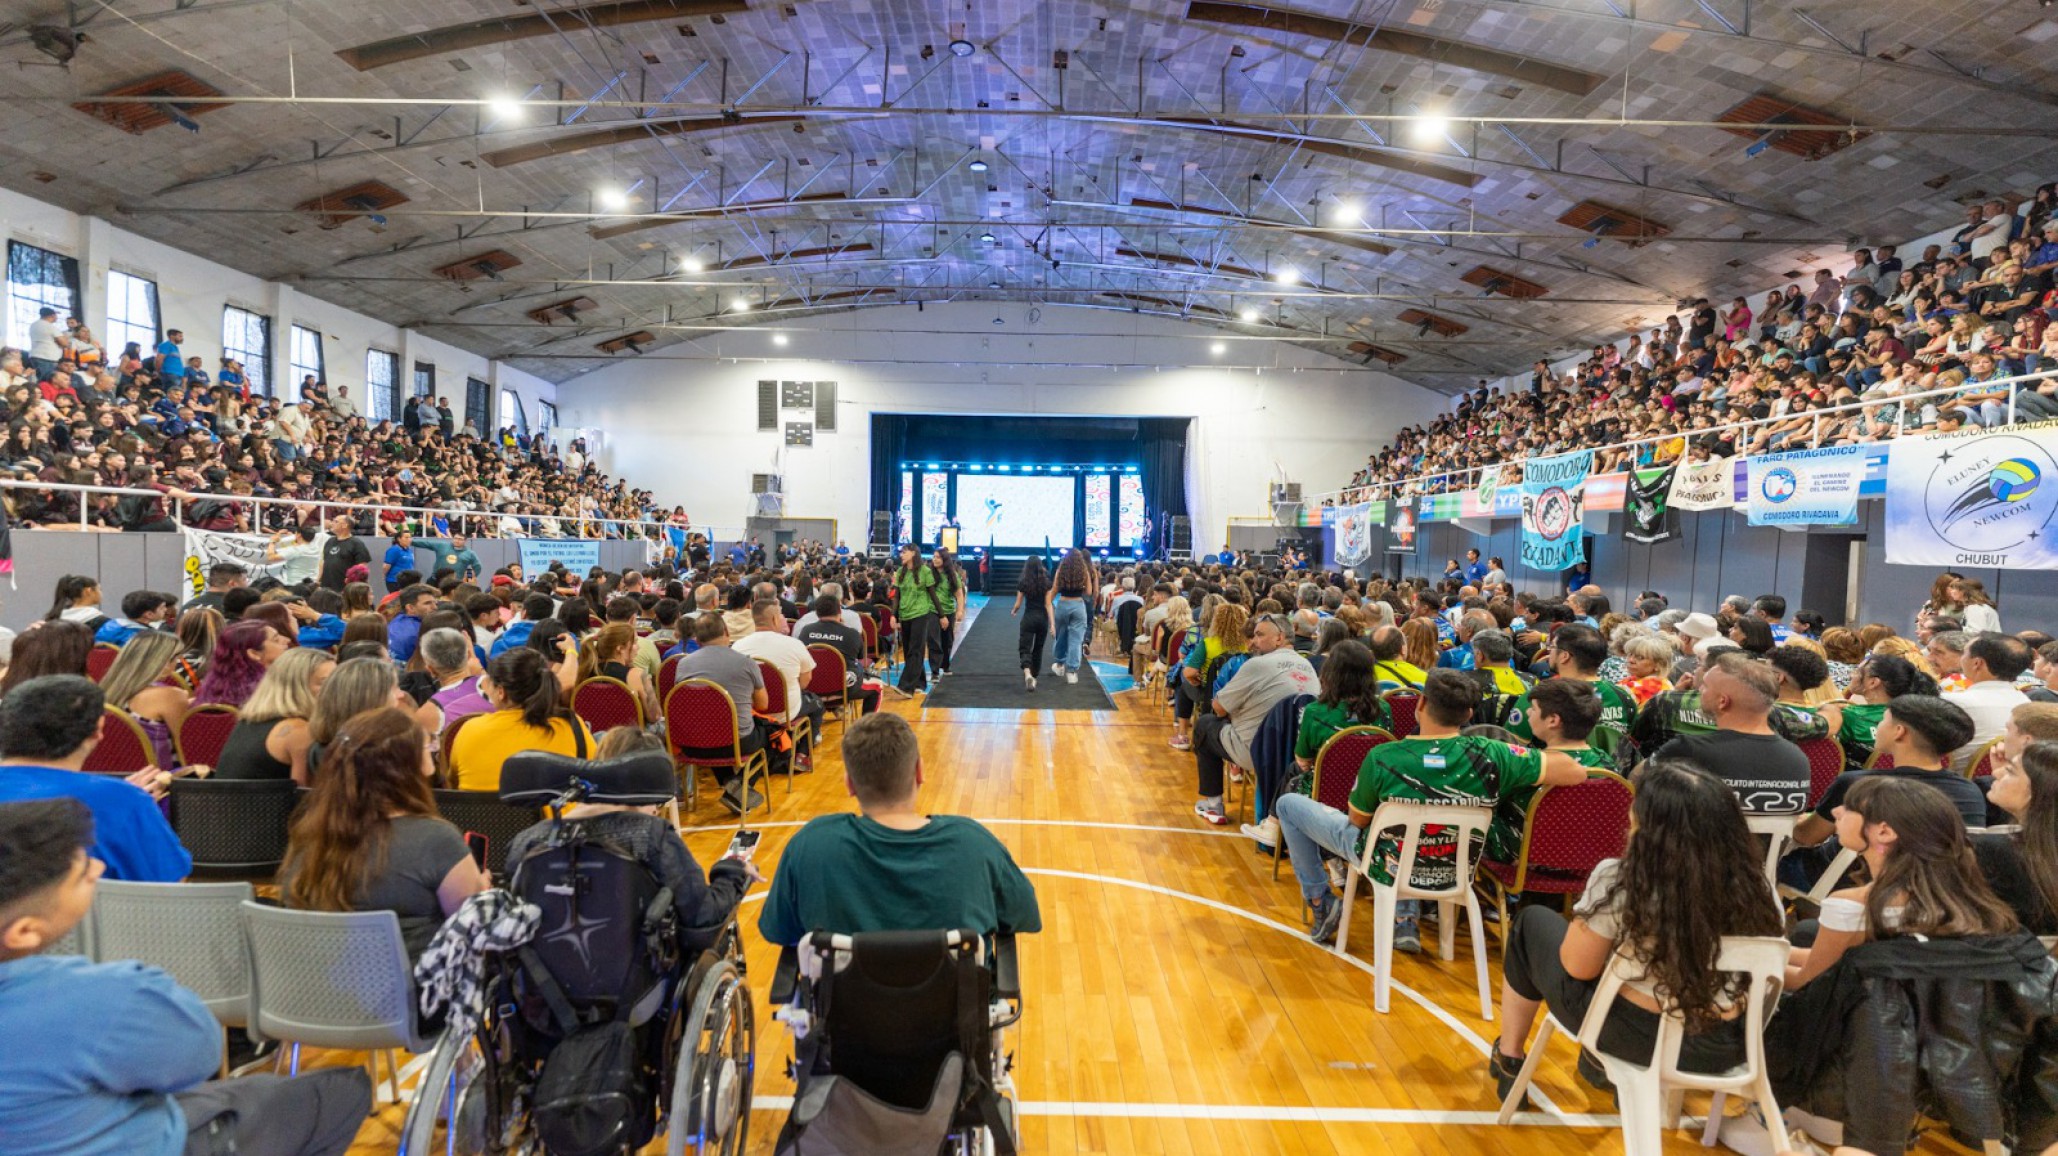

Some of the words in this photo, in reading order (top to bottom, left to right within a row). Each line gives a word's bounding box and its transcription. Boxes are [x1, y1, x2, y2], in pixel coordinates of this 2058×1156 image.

[1757, 453, 1783, 464] FARO
[1947, 456, 1992, 486] ELUNEY
[1763, 511, 1800, 521] COMODORO
[1802, 510, 1839, 519] RIVADAVIA
[1973, 502, 2032, 528] NEWCOM
[1956, 553, 2008, 565] CHUBUT
[809, 632, 844, 641] COACH
[1748, 779, 1800, 789] INTERNACIONAL
